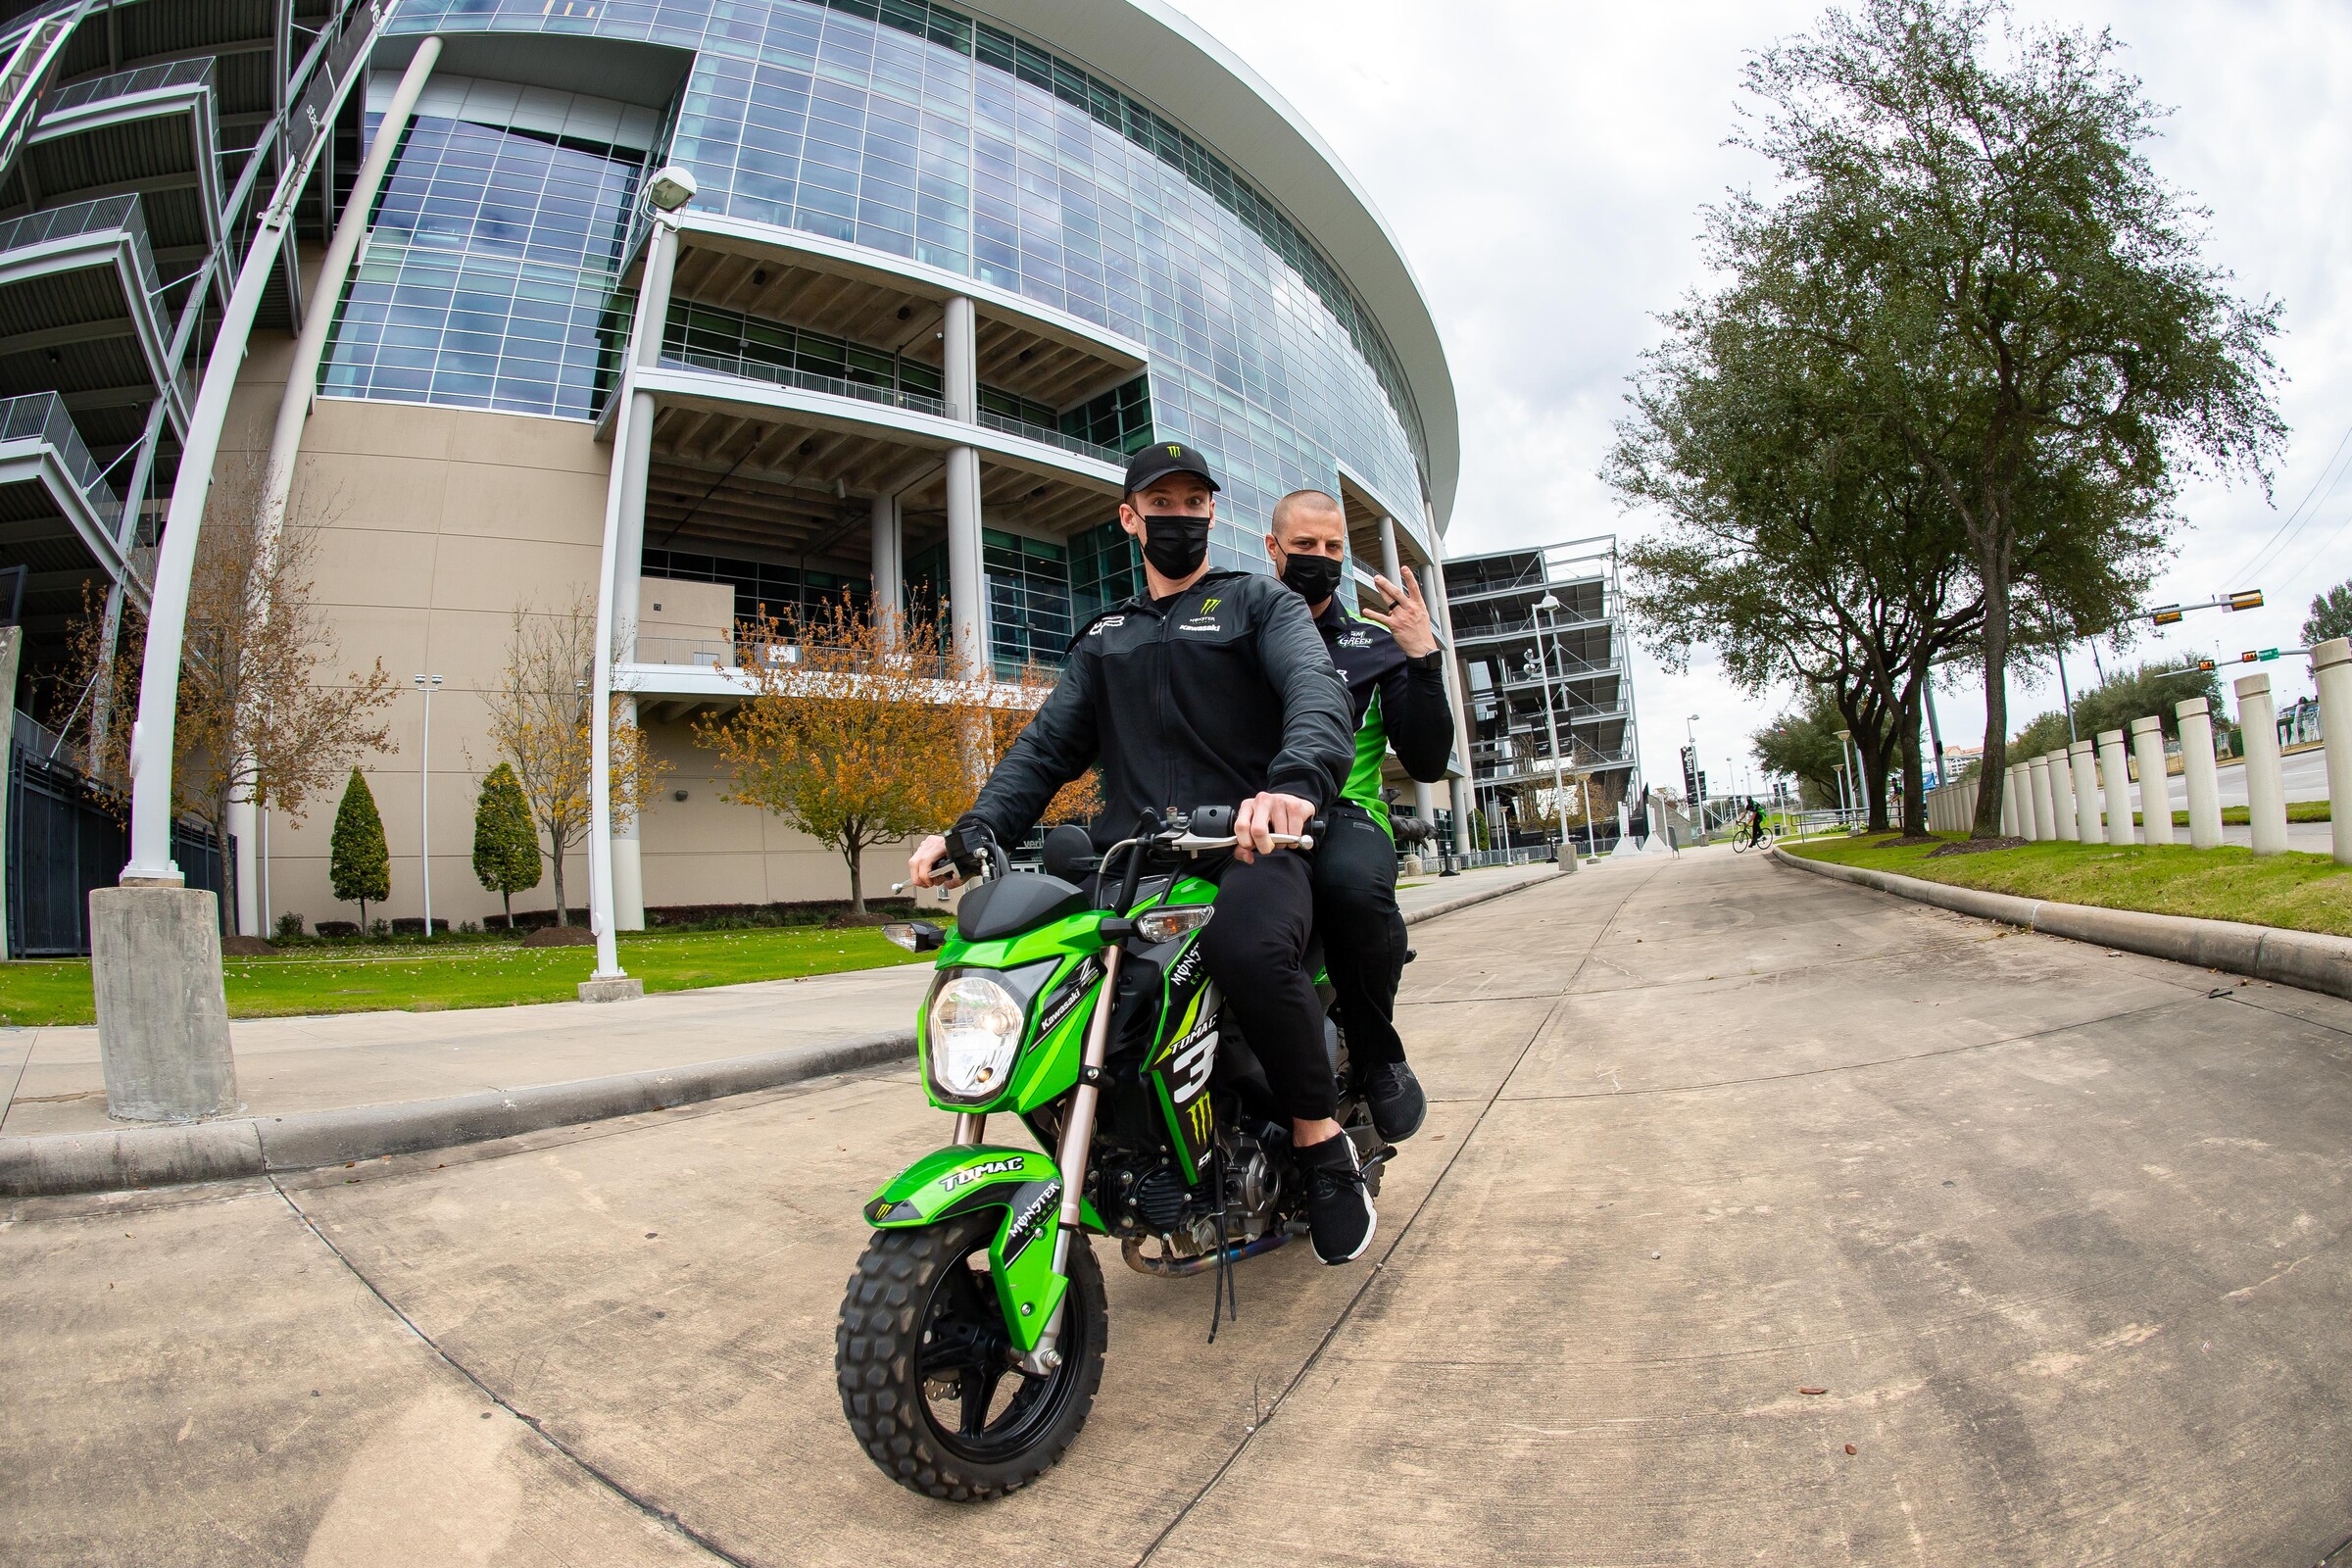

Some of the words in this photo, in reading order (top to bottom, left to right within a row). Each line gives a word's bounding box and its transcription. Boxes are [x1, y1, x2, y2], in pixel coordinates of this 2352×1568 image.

[1338, 637, 1373, 647] GREEN
[1041, 988, 1081, 1031] Kawasaki
[1170, 1013, 1218, 1054] TOMAC
[1173, 1030, 1219, 1103] 3
[939, 1155, 1024, 1192] TOMAC
[1008, 1182, 1060, 1238] MONSTER
[1024, 1198, 1057, 1237] ENERGY
